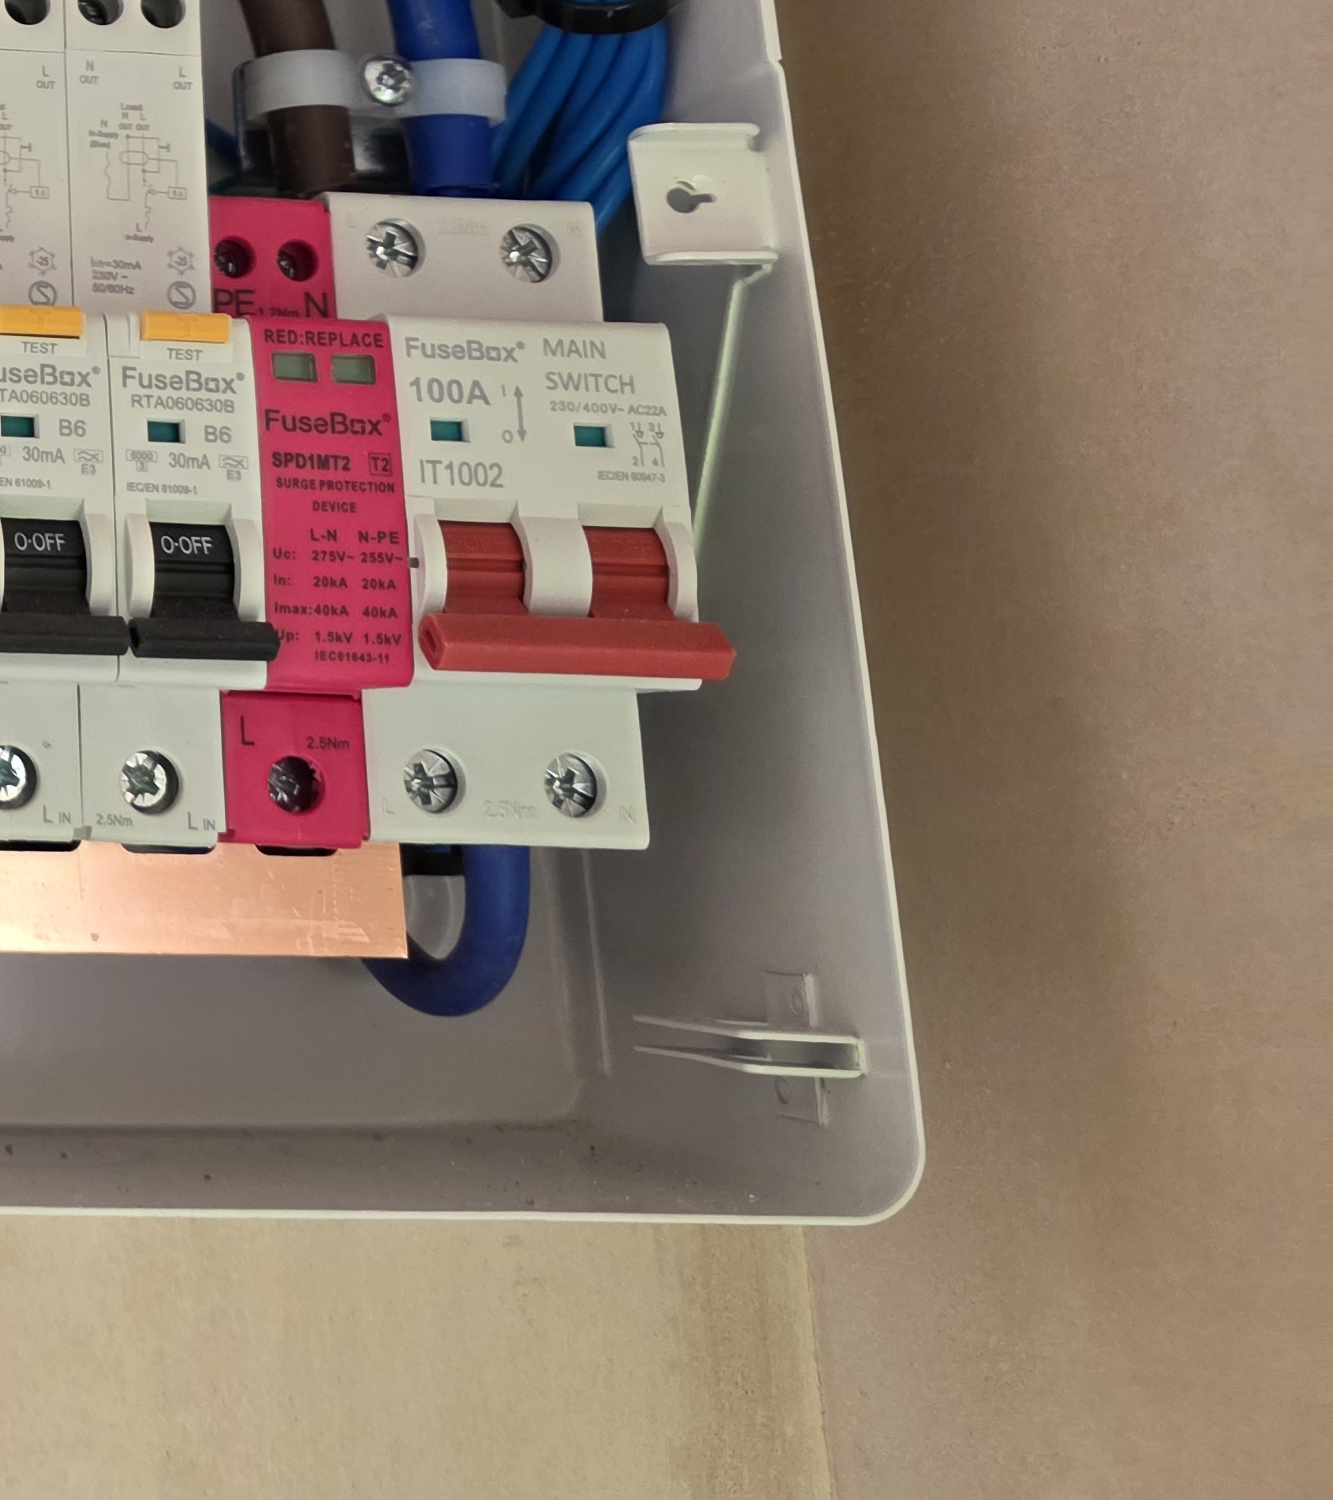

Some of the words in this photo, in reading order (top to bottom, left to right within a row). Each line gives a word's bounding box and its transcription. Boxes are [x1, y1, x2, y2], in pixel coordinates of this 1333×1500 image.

[213, 289, 256, 316] PE
[305, 292, 328, 318] N
[264, 328, 384, 348] RED:REPLACE
[21, 341, 57, 355] TEST
[167, 347, 202, 361] TEST
[542, 338, 606, 360] MAIN
[409, 377, 491, 406] 100A
[546, 372, 635, 395] SWITCH
[131, 394, 235, 413] RTA060630B
[59, 419, 87, 437] B6
[204, 425, 232, 444] B6
[22, 446, 65, 464] 30mA
[168, 452, 211, 470] 30mA
[271, 451, 351, 471] SPD1MT2
[371, 456, 390, 472] T2
[420, 459, 504, 488] IT1002
[276, 477, 316, 490] SURGE
[319, 479, 395, 493] PROTECTION
[312, 501, 357, 513] DEVICE
[310, 528, 337, 542] L-N
[357, 530, 399, 544] N-PE
[313, 576, 348, 589] 20kA
[361, 578, 396, 590] 20kA
[314, 604, 349, 617] 40kA
[362, 606, 398, 619] 40kA
[314, 631, 353, 644] 1.5kV
[363, 632, 402, 645] 1.5kV
[240, 714, 255, 746] L
[306, 736, 350, 750] 2.5Nm
